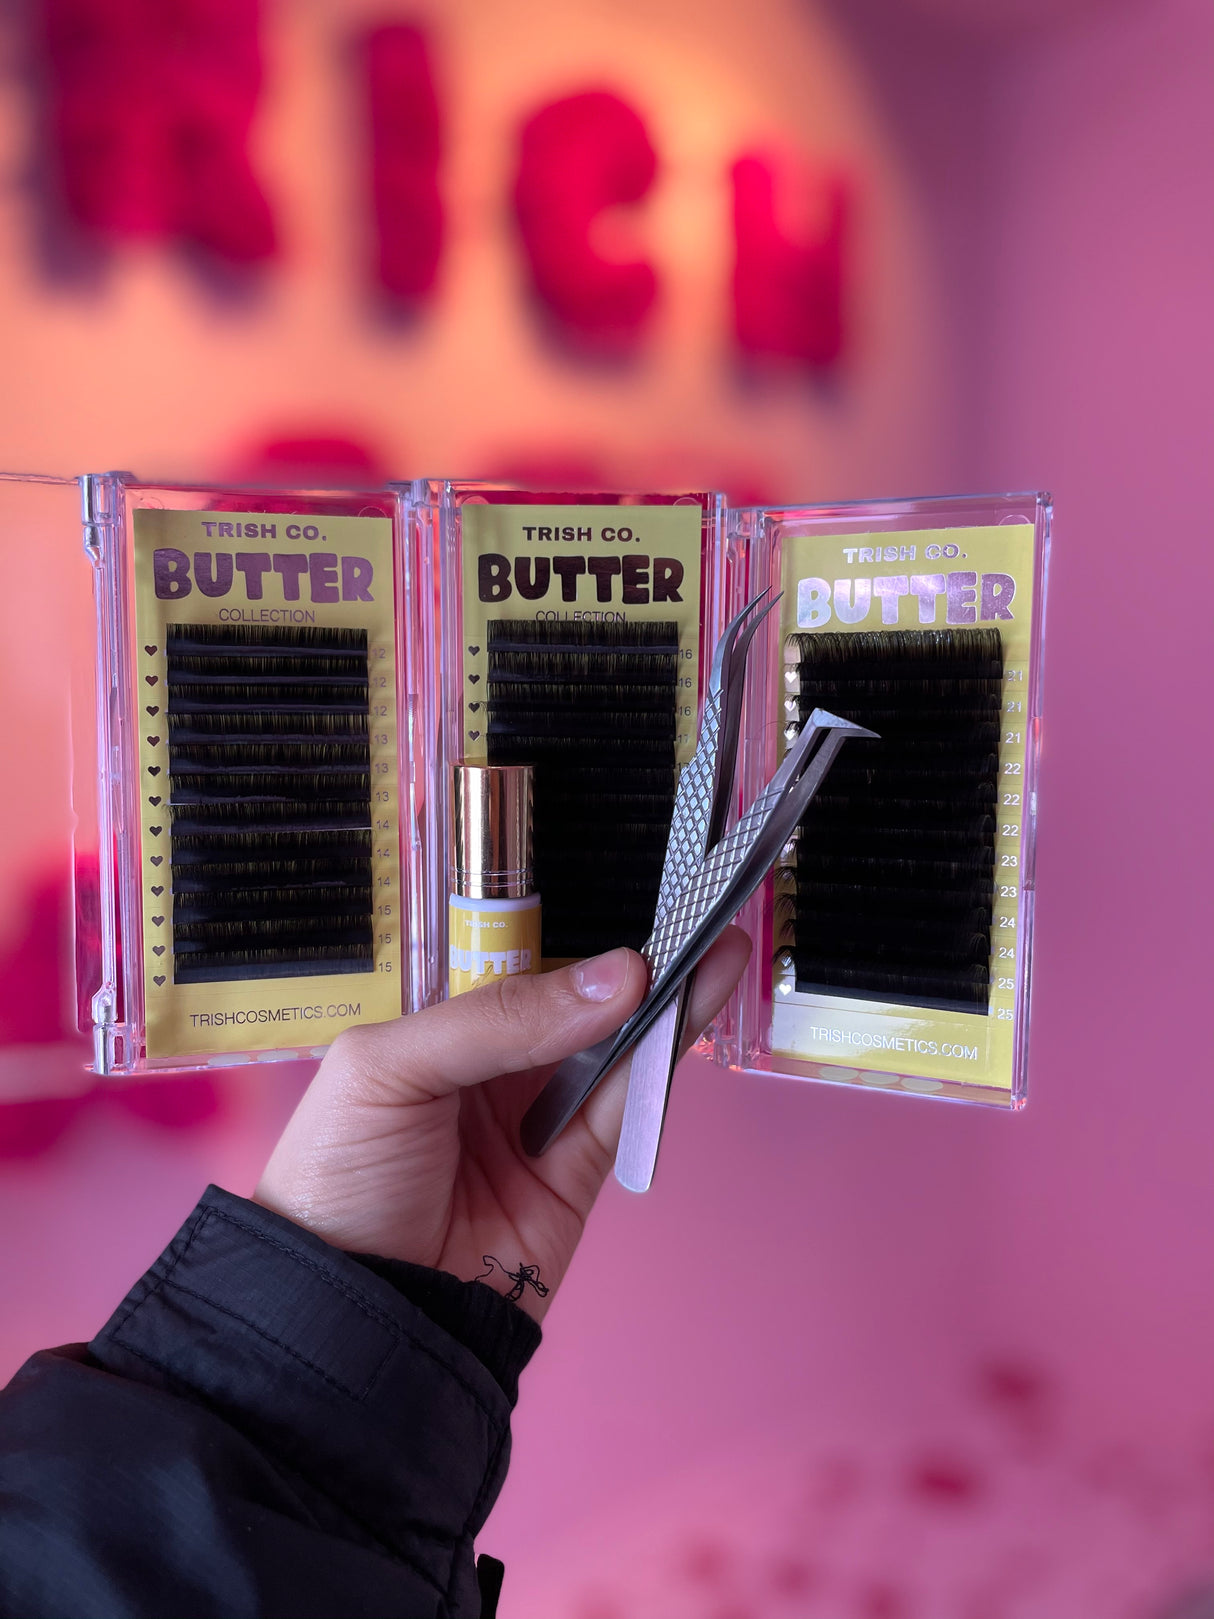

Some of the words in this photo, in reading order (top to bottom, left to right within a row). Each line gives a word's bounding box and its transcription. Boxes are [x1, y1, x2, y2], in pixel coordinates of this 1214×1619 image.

[201, 521, 277, 539] TRISH
[285, 524, 327, 541] CO.
[522, 526, 592, 542] TRISH
[601, 527, 640, 542] CO.
[842, 545, 916, 564] TRISH
[925, 543, 968, 560] CO.
[153, 547, 375, 603] BUTTER
[477, 552, 685, 605] BUTTER
[796, 571, 1017, 629] BUTTER
[218, 608, 316, 623] COLLECTION
[679, 648, 693, 660] 16
[1007, 670, 1023, 682] 21
[373, 677, 387, 688] 12
[678, 677, 692, 689] 16
[374, 705, 388, 717] 12
[678, 706, 691, 717] 16
[1006, 701, 1022, 713] 21
[374, 734, 388, 745] 13
[1005, 732, 1021, 744] 21
[375, 762, 389, 774] 13
[1004, 763, 1021, 775] 22
[375, 791, 390, 802] 13
[1003, 793, 1020, 806] 22
[376, 819, 390, 830] 14
[1002, 824, 1019, 837] 22
[376, 848, 390, 858] 14
[1001, 855, 1018, 867] 23
[377, 877, 391, 887] 14
[1000, 885, 1017, 898] 23
[377, 905, 392, 916] 15
[999, 916, 1016, 929] 24
[378, 933, 392, 944] 15
[449, 943, 532, 975] BUTTER
[998, 947, 1015, 959] 24
[378, 962, 393, 973] 15
[998, 977, 1015, 990] 25
[189, 1002, 362, 1028] TRISHCOSMETICS.COM
[997, 1008, 1014, 1021] 25
[809, 1026, 979, 1061] TRISHCOSMETICS.COM
